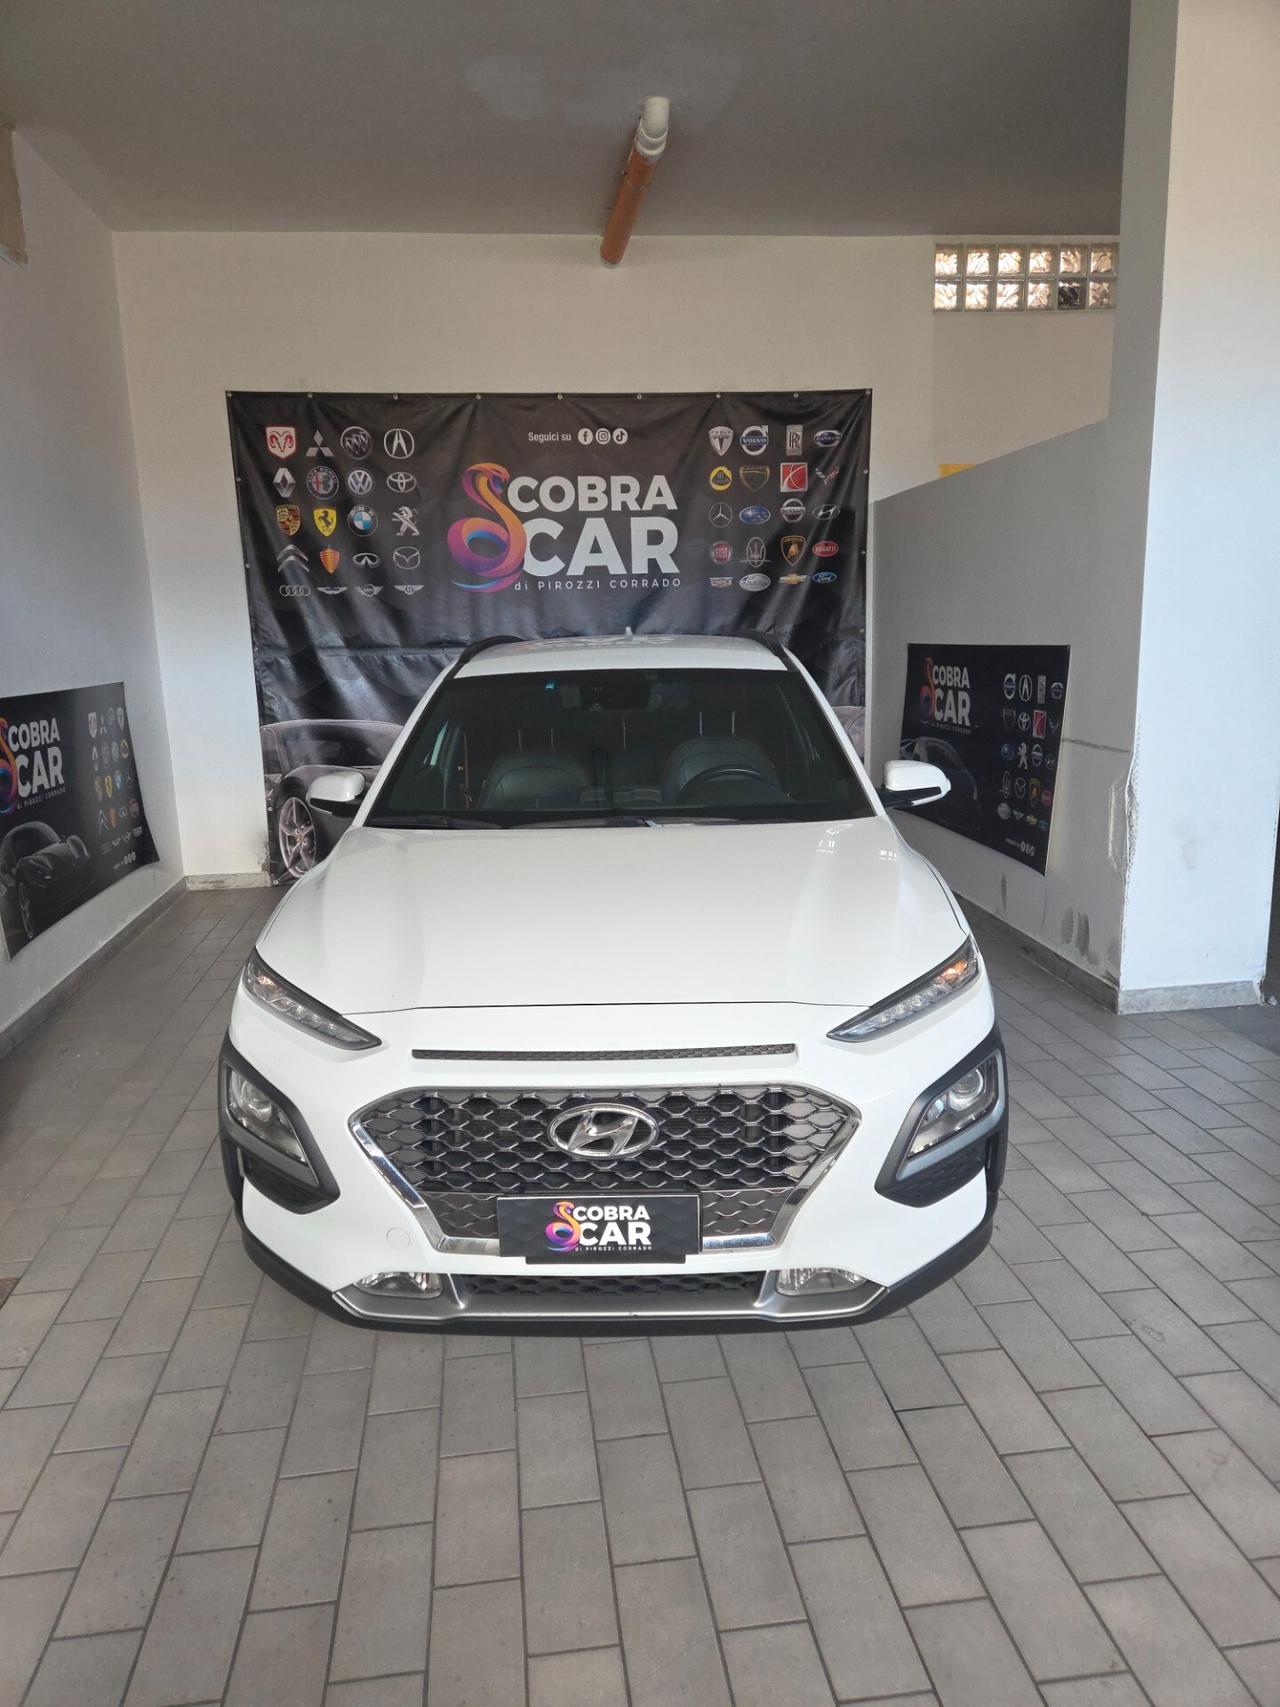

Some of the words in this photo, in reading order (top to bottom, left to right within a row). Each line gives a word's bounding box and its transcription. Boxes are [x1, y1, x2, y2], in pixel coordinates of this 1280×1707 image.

[528, 431, 559, 445] Seguici
[561, 433, 572, 442] su
[507, 474, 678, 513] COBRA
[522, 516, 680, 577] CAR
[514, 581, 528, 591] di
[538, 579, 601, 590] PIROZZI
[609, 578, 681, 589] CORRADO
[932, 665, 971, 689] COBRA
[934, 688, 971, 726] CAR
[8, 717, 61, 752] COBRA
[16, 746, 65, 798] CAR
[572, 1205, 651, 1221] COBRA
[579, 1221, 652, 1247] CAR
